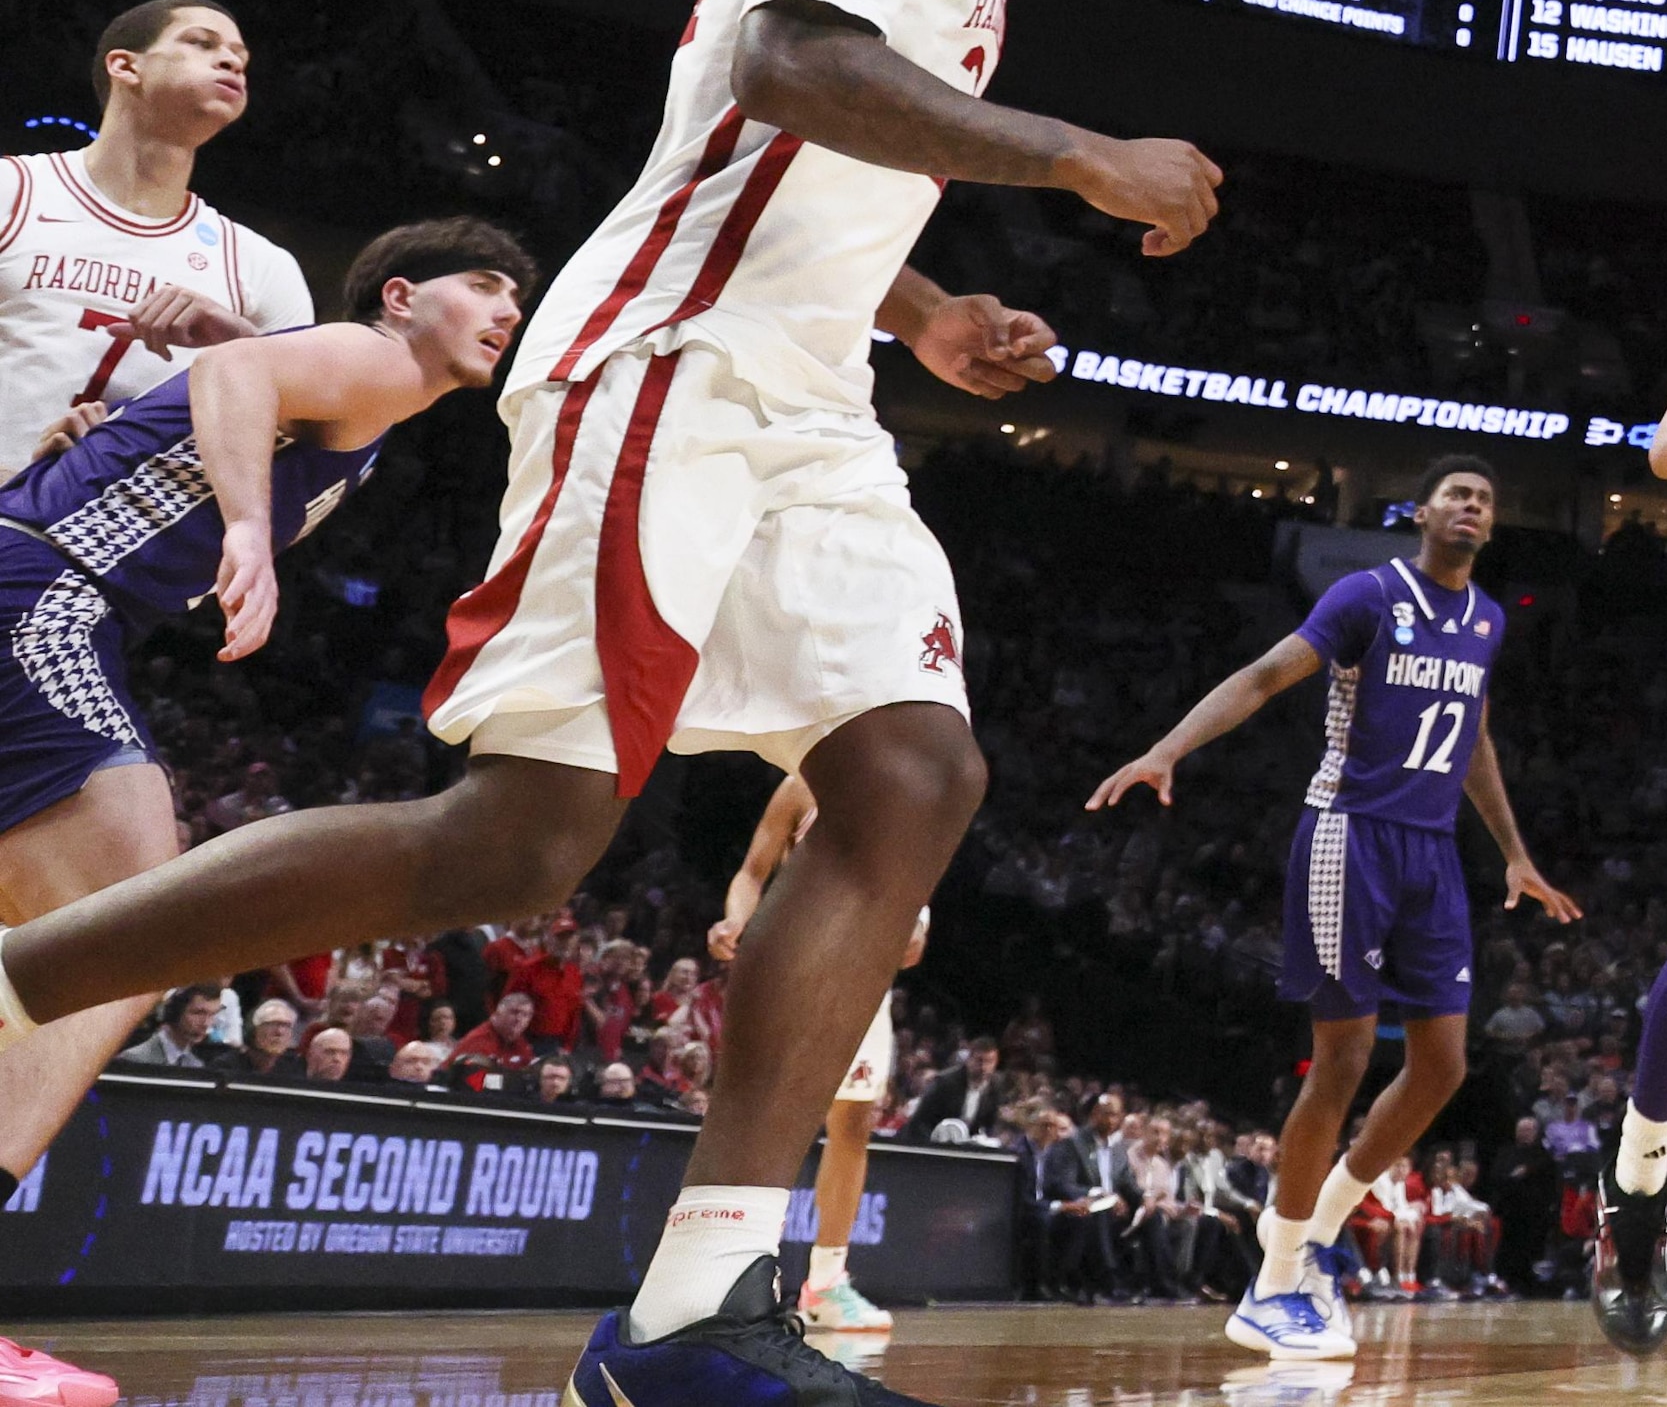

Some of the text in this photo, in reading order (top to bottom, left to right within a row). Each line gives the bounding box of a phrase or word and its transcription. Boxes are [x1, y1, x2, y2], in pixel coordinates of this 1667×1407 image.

[1342, 5, 1405, 35] POINTS
[1526, 30, 1559, 59] 15
[1565, 35, 1664, 73] HAUSEN
[23, 255, 157, 304] RAZORBA
[1072, 351, 1289, 408] BASKETBALL
[1297, 385, 1570, 439] CHAMPIONSHIP
[1386, 654, 1486, 698] HIGH POINT
[1402, 701, 1465, 773] 12
[141, 1120, 599, 1221] NCAA SECOND ROUND
[223, 1221, 529, 1256] HOSTED BY OREGON STATE UNIVERSITY
[672, 1209, 745, 1227] preme
